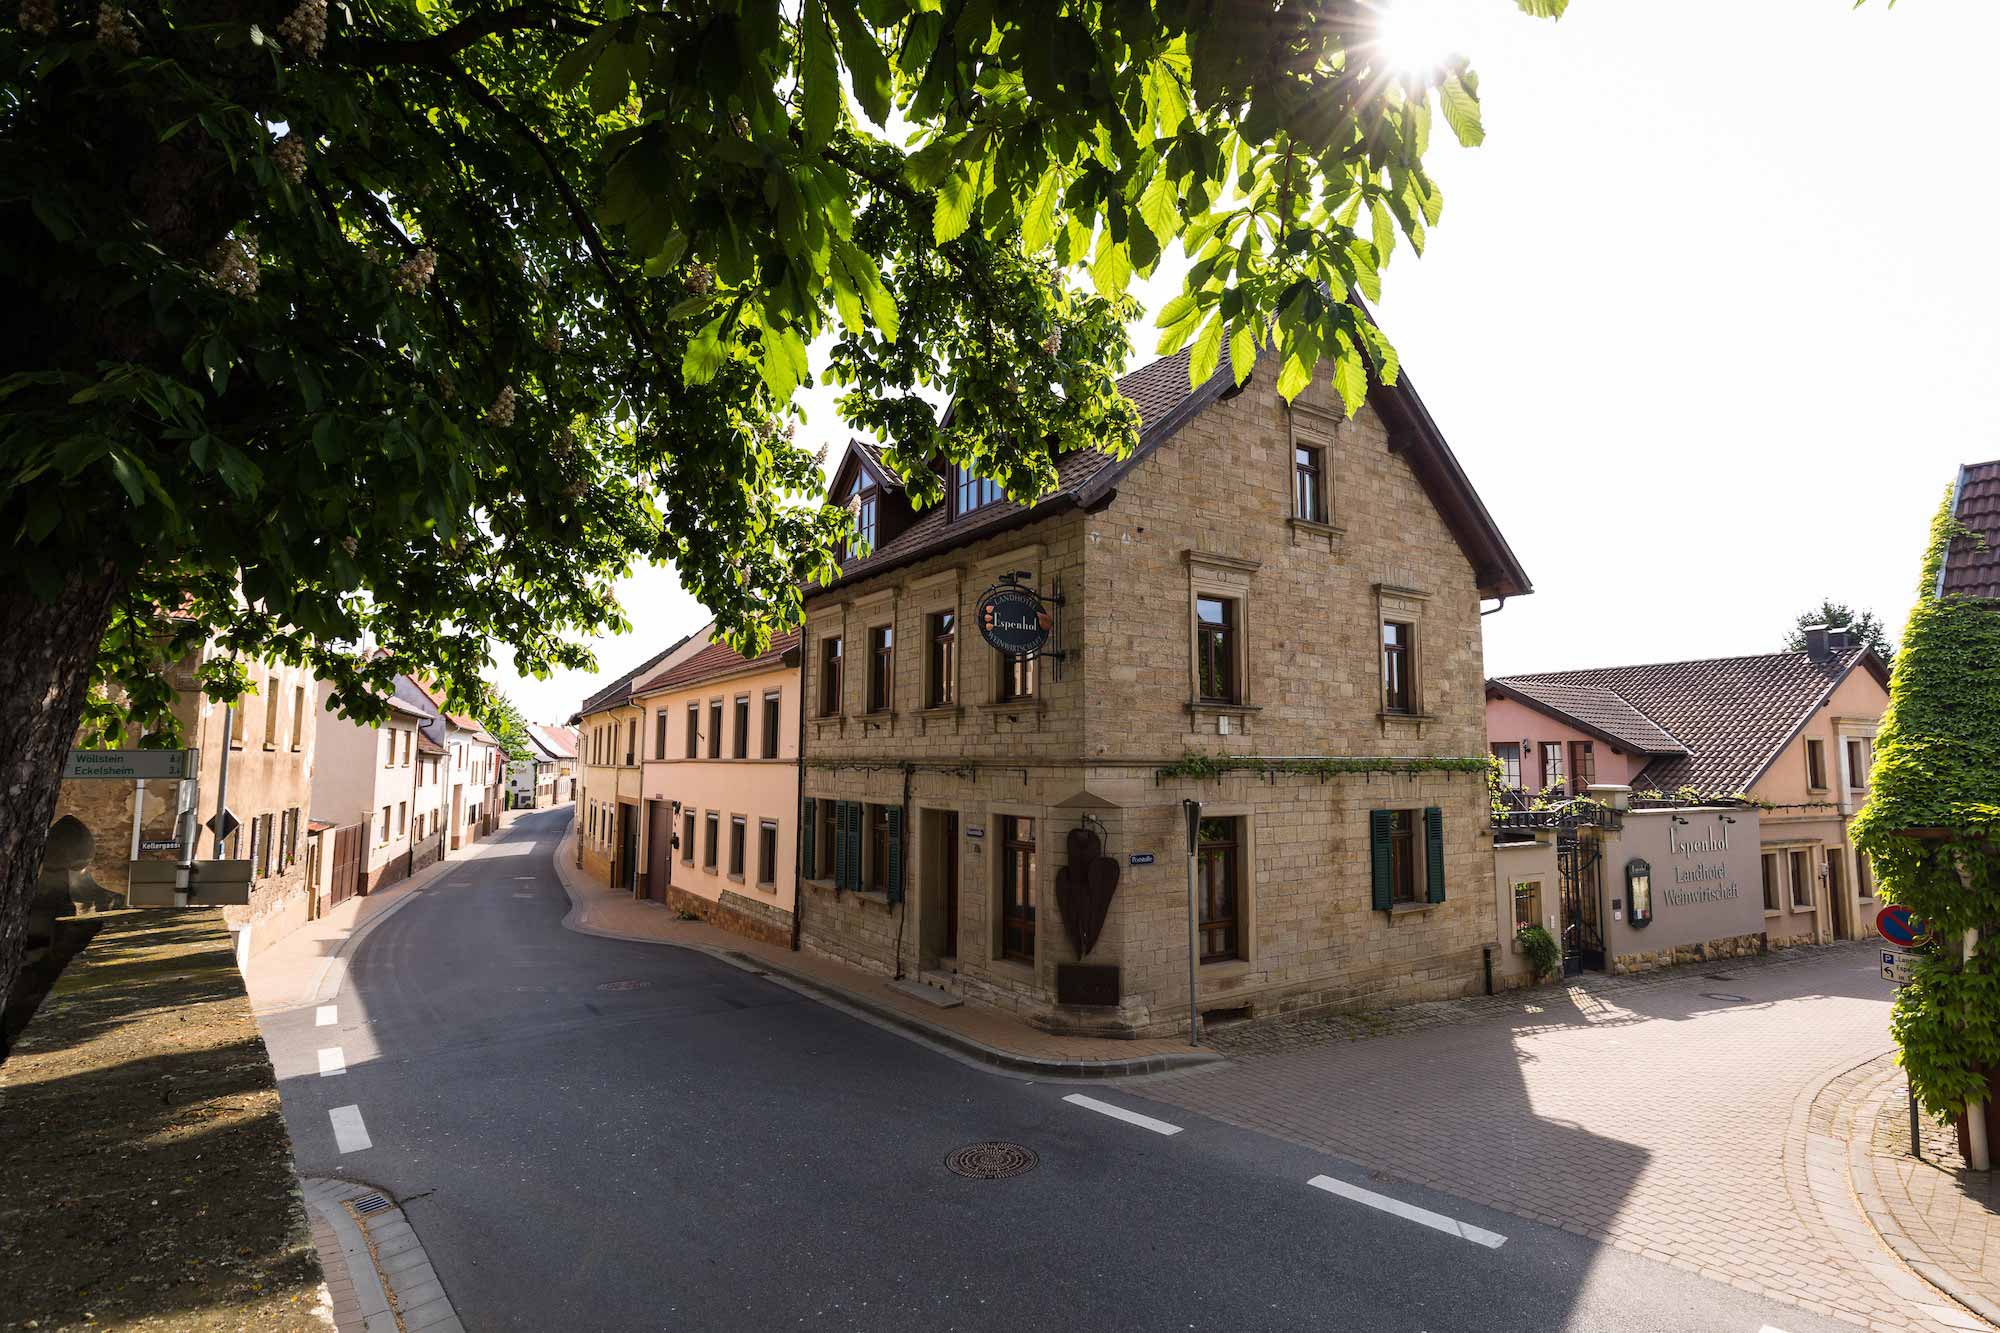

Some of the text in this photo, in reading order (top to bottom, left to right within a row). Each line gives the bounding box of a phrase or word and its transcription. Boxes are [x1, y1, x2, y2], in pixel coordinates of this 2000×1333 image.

[74, 766, 134, 776] Eckelsheim
[1674, 862, 1727, 884] Landhotel
[1663, 880, 1739, 907] Weinwirtschaft
